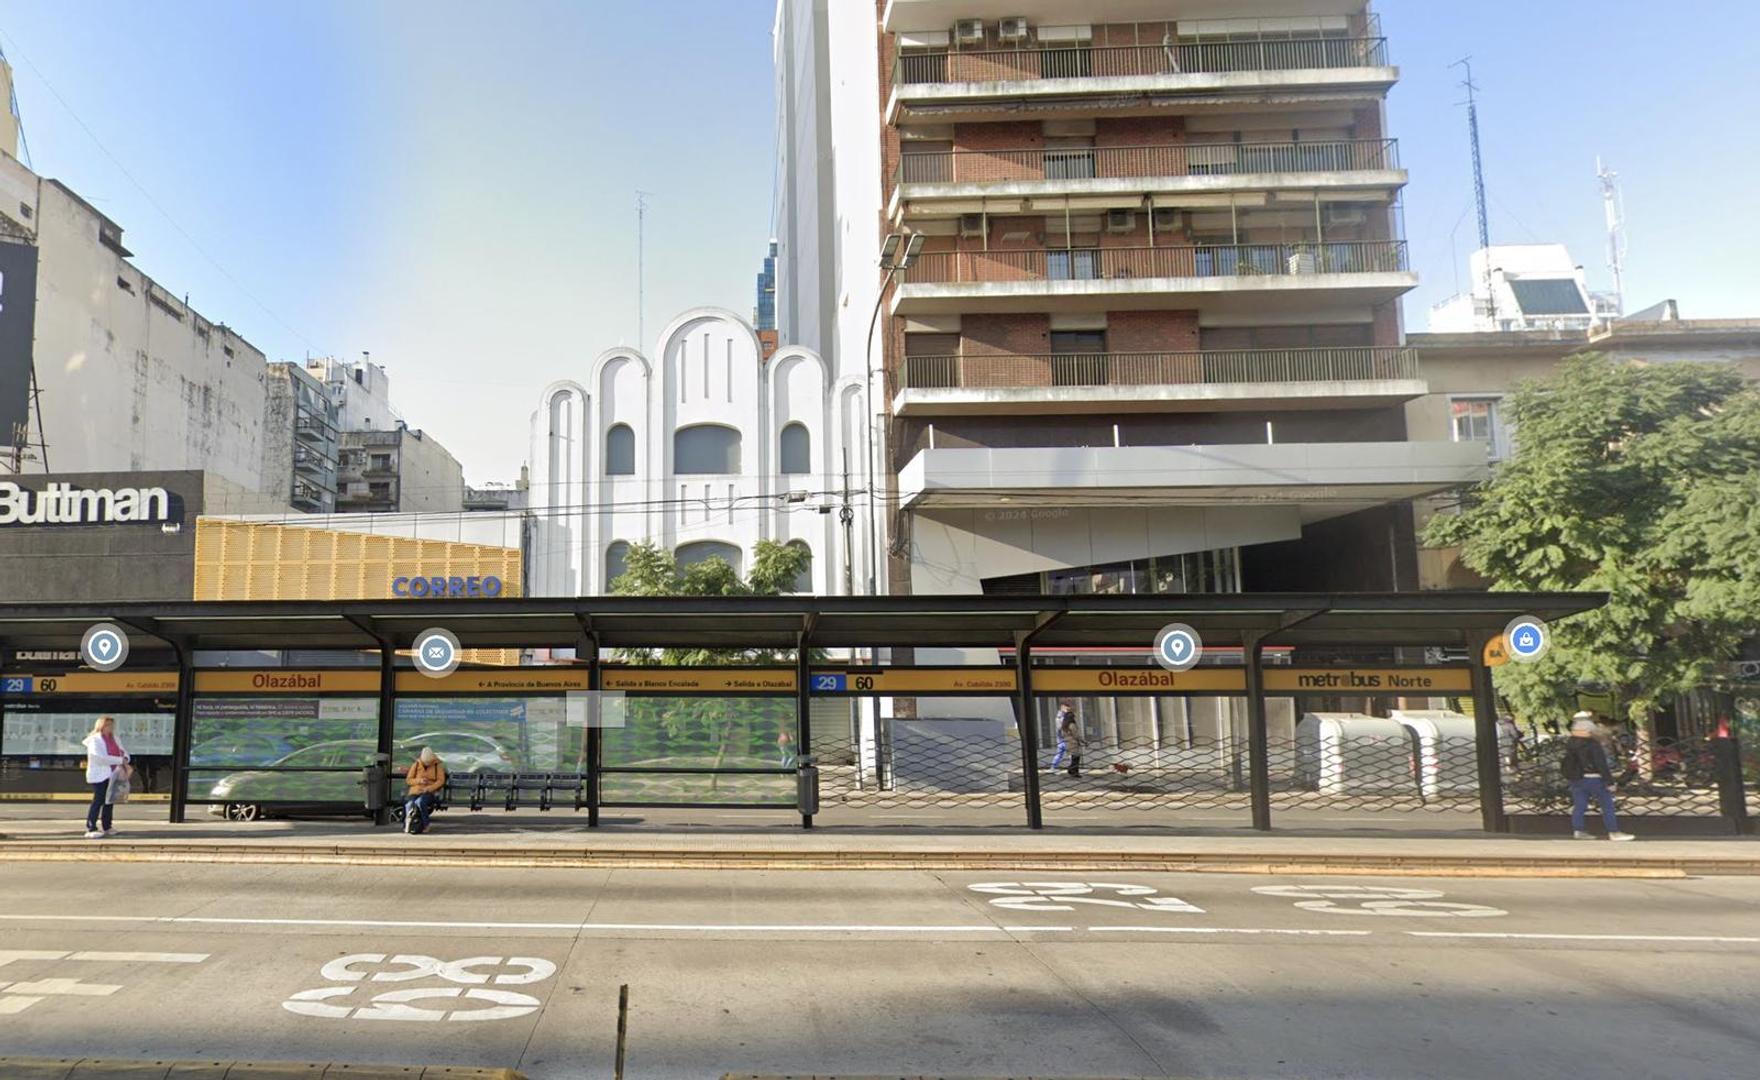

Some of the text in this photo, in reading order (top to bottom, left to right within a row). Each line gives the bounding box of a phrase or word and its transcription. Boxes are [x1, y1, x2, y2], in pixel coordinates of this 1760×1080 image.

[0, 482, 168, 523] Buttman
[392, 576, 502, 597] CORREO
[7, 679, 57, 692] 29 60
[252, 673, 321, 688] Olazábal
[818, 676, 874, 690] 29 60
[1098, 671, 1175, 687] Olazábal
[1388, 674, 1432, 687] Norte
